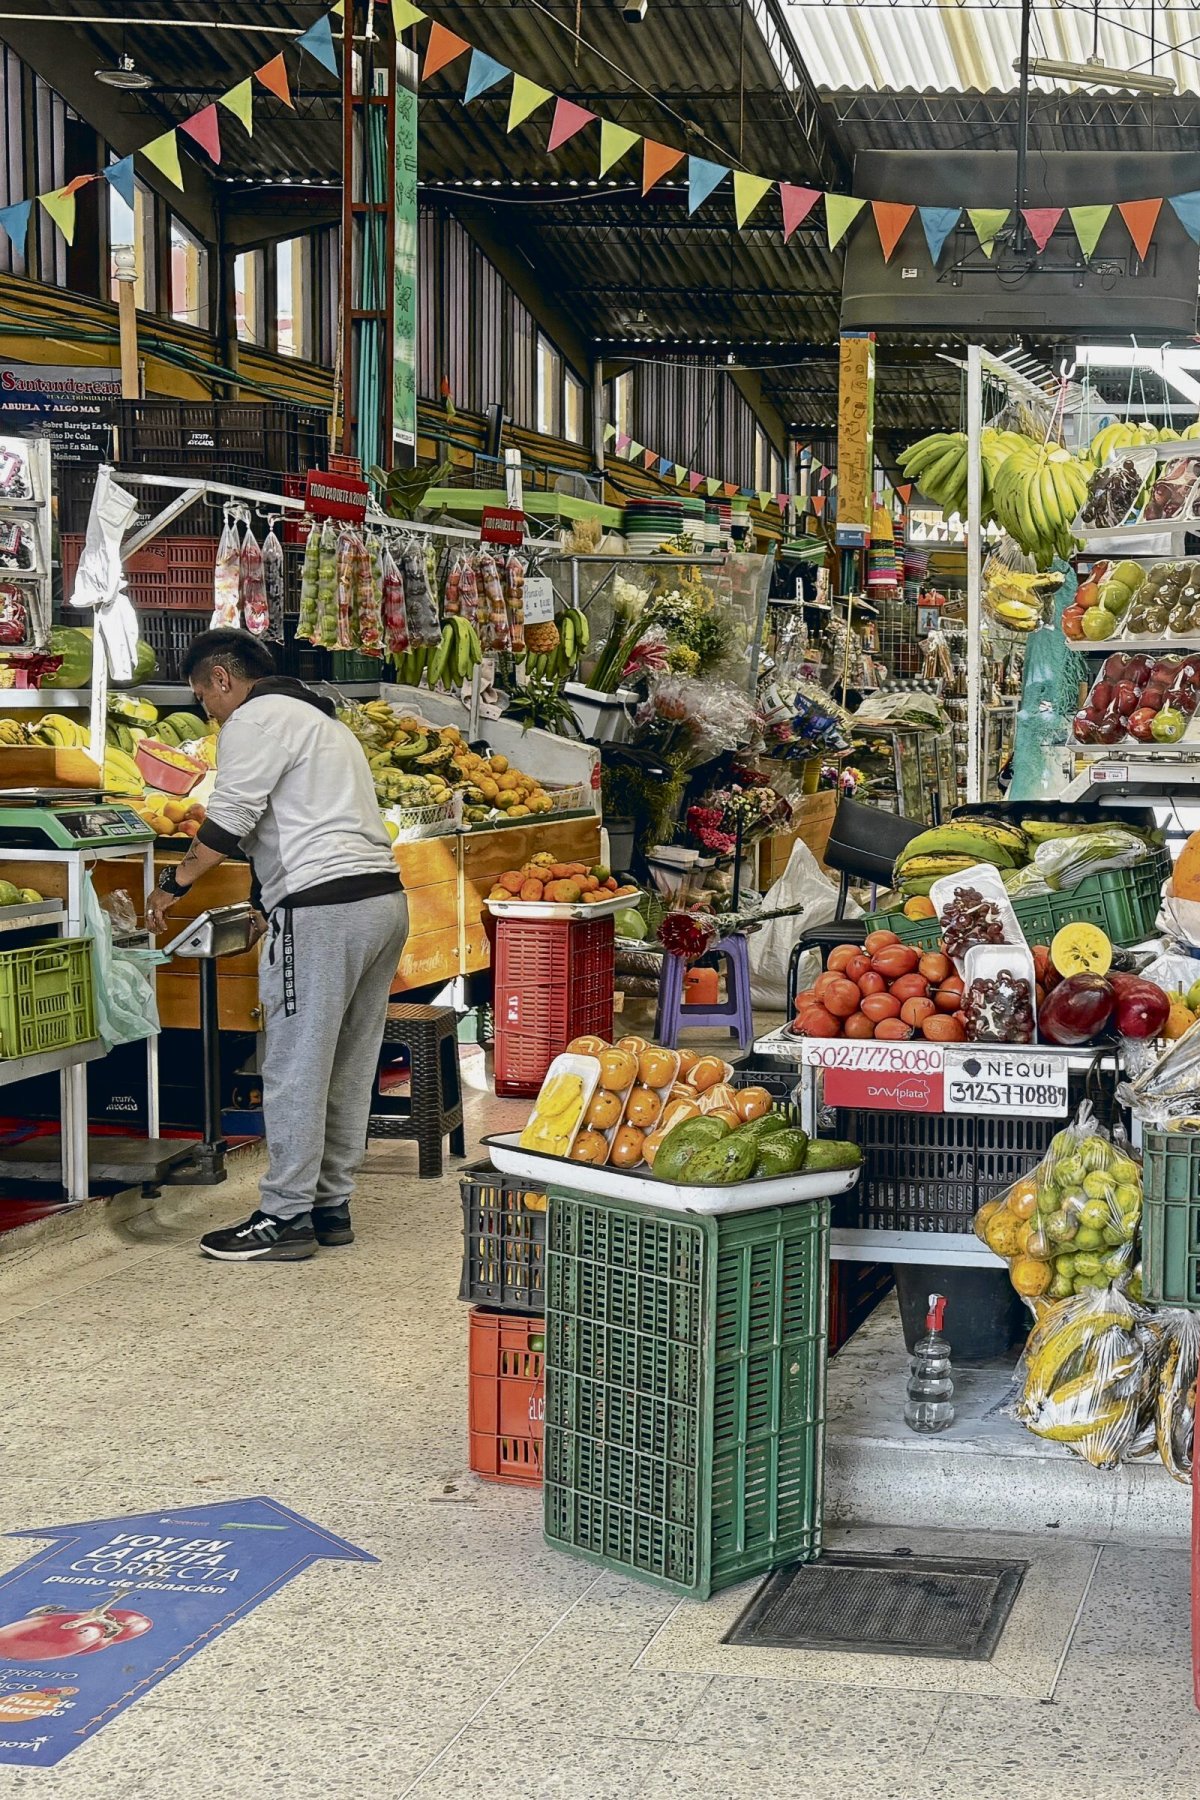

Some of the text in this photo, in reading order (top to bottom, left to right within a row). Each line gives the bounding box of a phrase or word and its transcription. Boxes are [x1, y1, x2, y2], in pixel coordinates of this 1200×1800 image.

[2, 403, 40, 411] ABUELA
[807, 1046, 942, 1071] 3027778080
[988, 1061, 1053, 1078] NEQUI
[951, 1082, 1067, 1107] 3125770889
[108, 1534, 234, 1553] VOY EN
[84, 1546, 226, 1566] LA RUTA
[70, 1558, 240, 1582] CORRECTA
[42, 1575, 228, 1594] punto de donación
[6, 1696, 77, 1708] Plaza de
